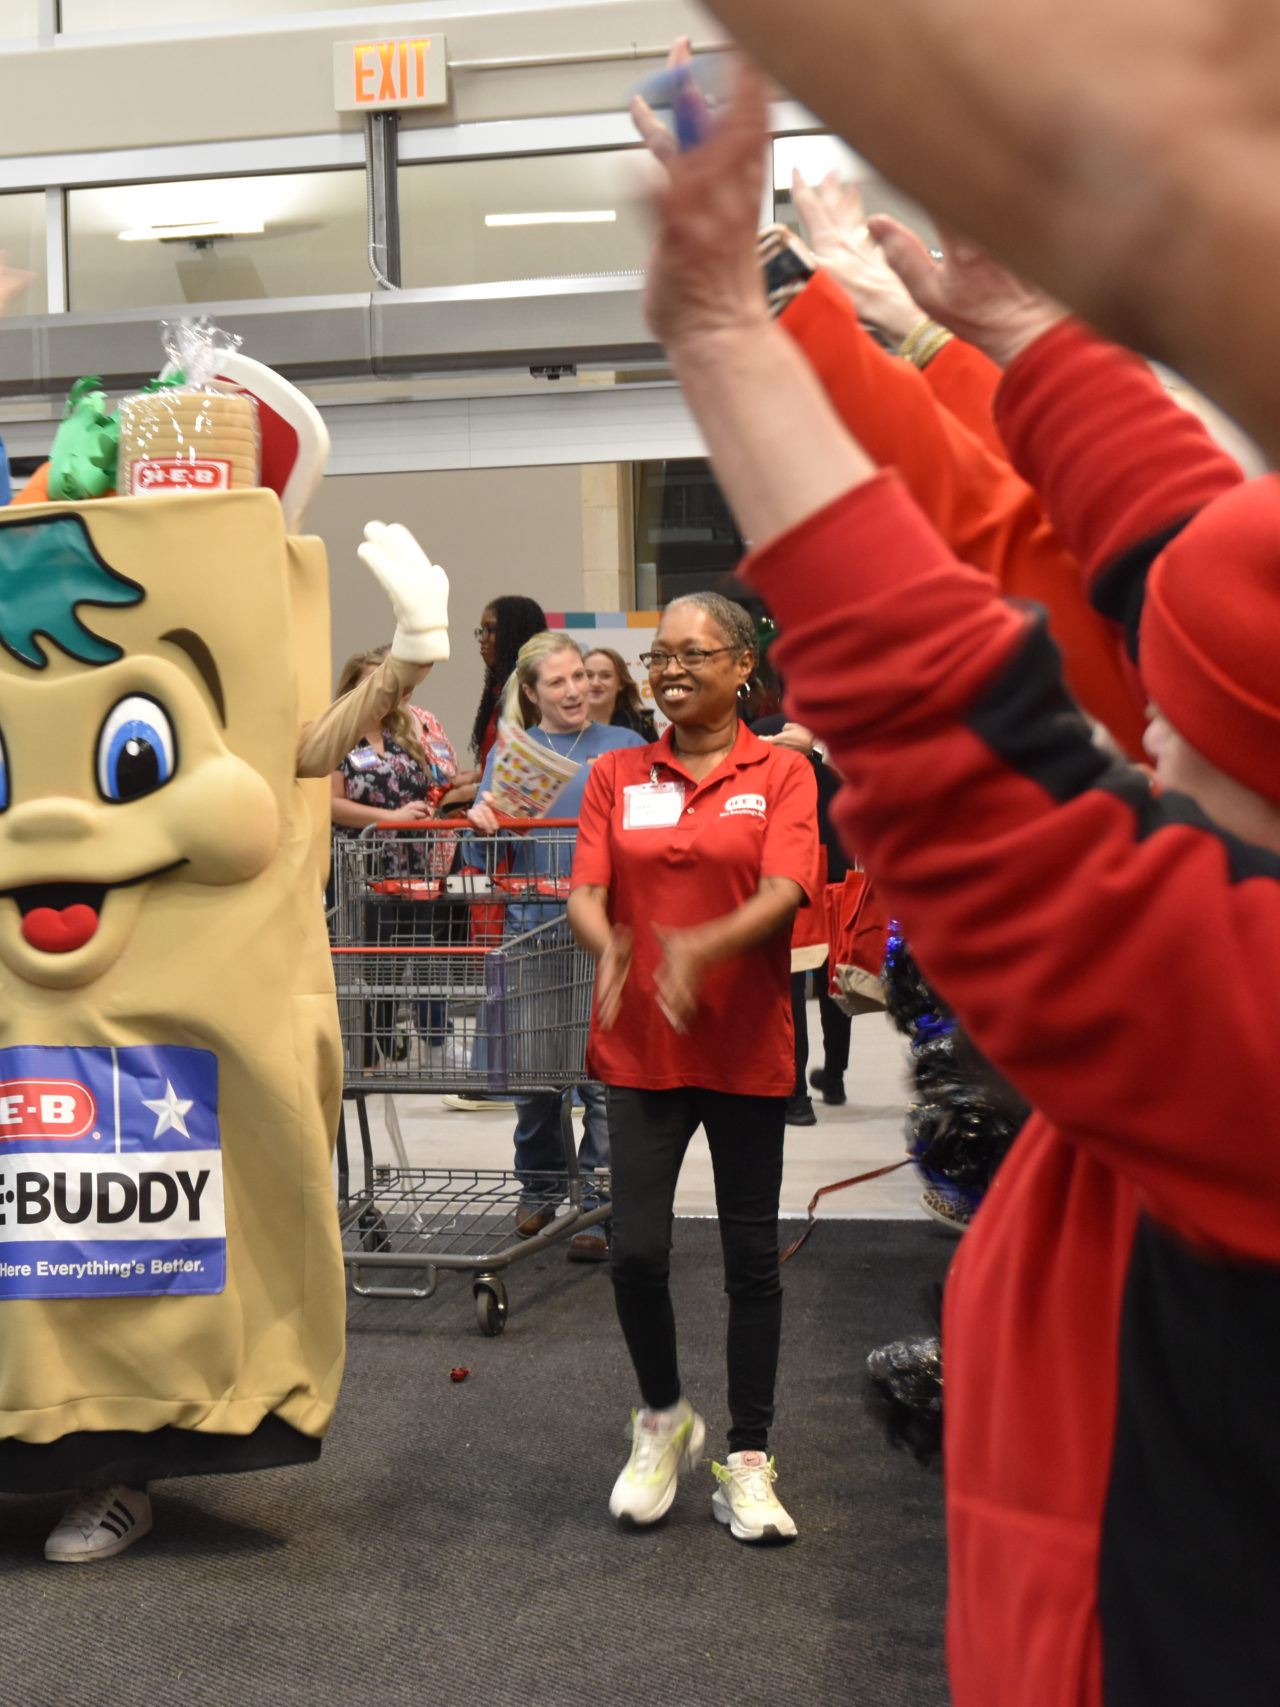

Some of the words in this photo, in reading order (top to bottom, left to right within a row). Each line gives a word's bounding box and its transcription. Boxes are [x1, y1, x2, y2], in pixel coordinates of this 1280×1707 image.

[354, 39, 431, 103] EXIT
[141, 467, 215, 484] H-E-B
[0, 1262, 31, 1277] Here
[37, 1259, 145, 1279] Everything's
[151, 1259, 205, 1275] Better.
